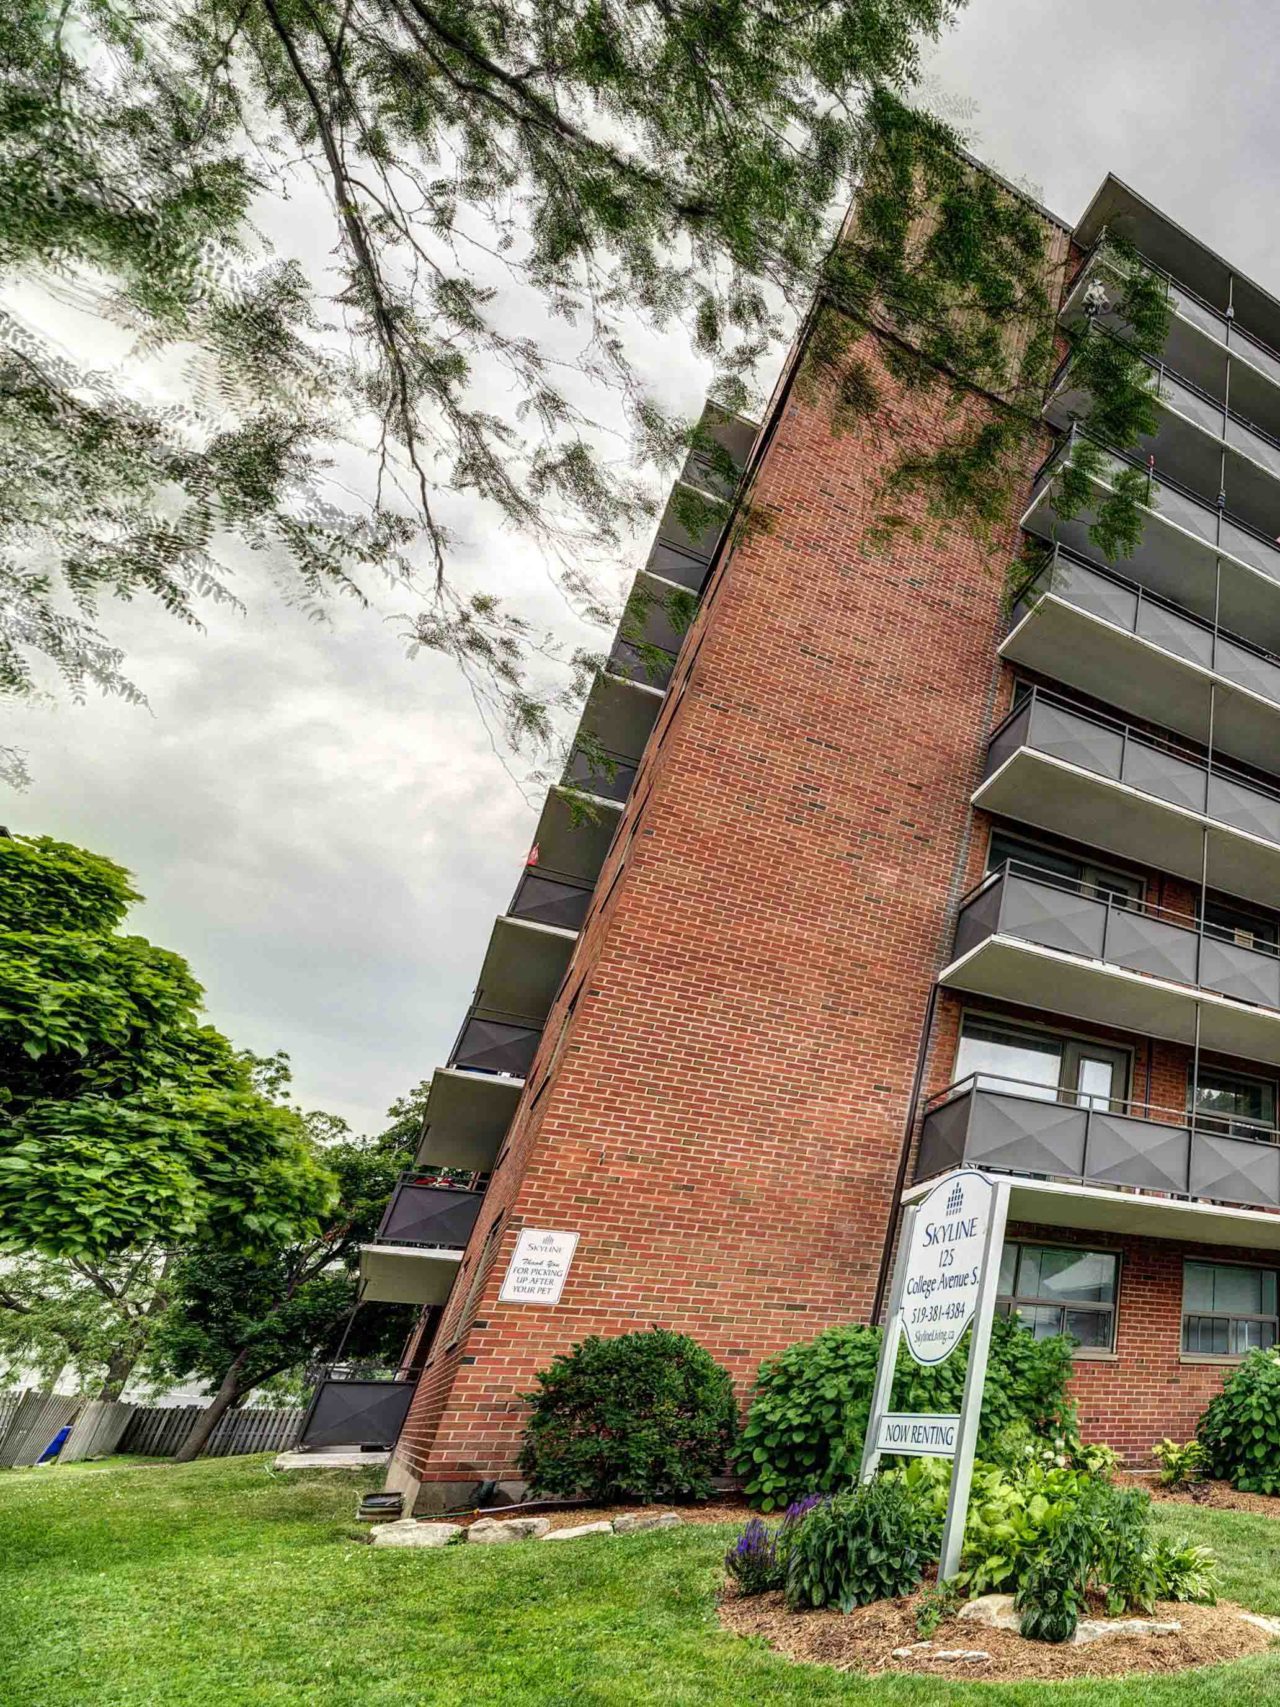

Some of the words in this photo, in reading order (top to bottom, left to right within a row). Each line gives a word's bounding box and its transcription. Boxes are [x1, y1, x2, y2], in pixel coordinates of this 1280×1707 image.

[922, 1217, 978, 1247] SKYLINE
[527, 1243, 563, 1253] SKYLINE
[522, 1258, 545, 1266] Thank
[939, 1248, 955, 1268] 125
[513, 1267, 529, 1275] FOR
[530, 1268, 563, 1277] PICKING
[516, 1276, 528, 1284] UP
[529, 1277, 554, 1286] AFTER
[513, 1286, 535, 1294] YOUR
[536, 1287, 553, 1295] PET
[906, 1275, 937, 1299] College
[937, 1273, 969, 1290] Avenue
[970, 1266, 980, 1285] S.
[911, 1301, 966, 1324] 519-381-4384
[914, 1329, 955, 1347] SkylineLiving.ca
[885, 1424, 911, 1443] NOW
[911, 1425, 954, 1446] RENTING
